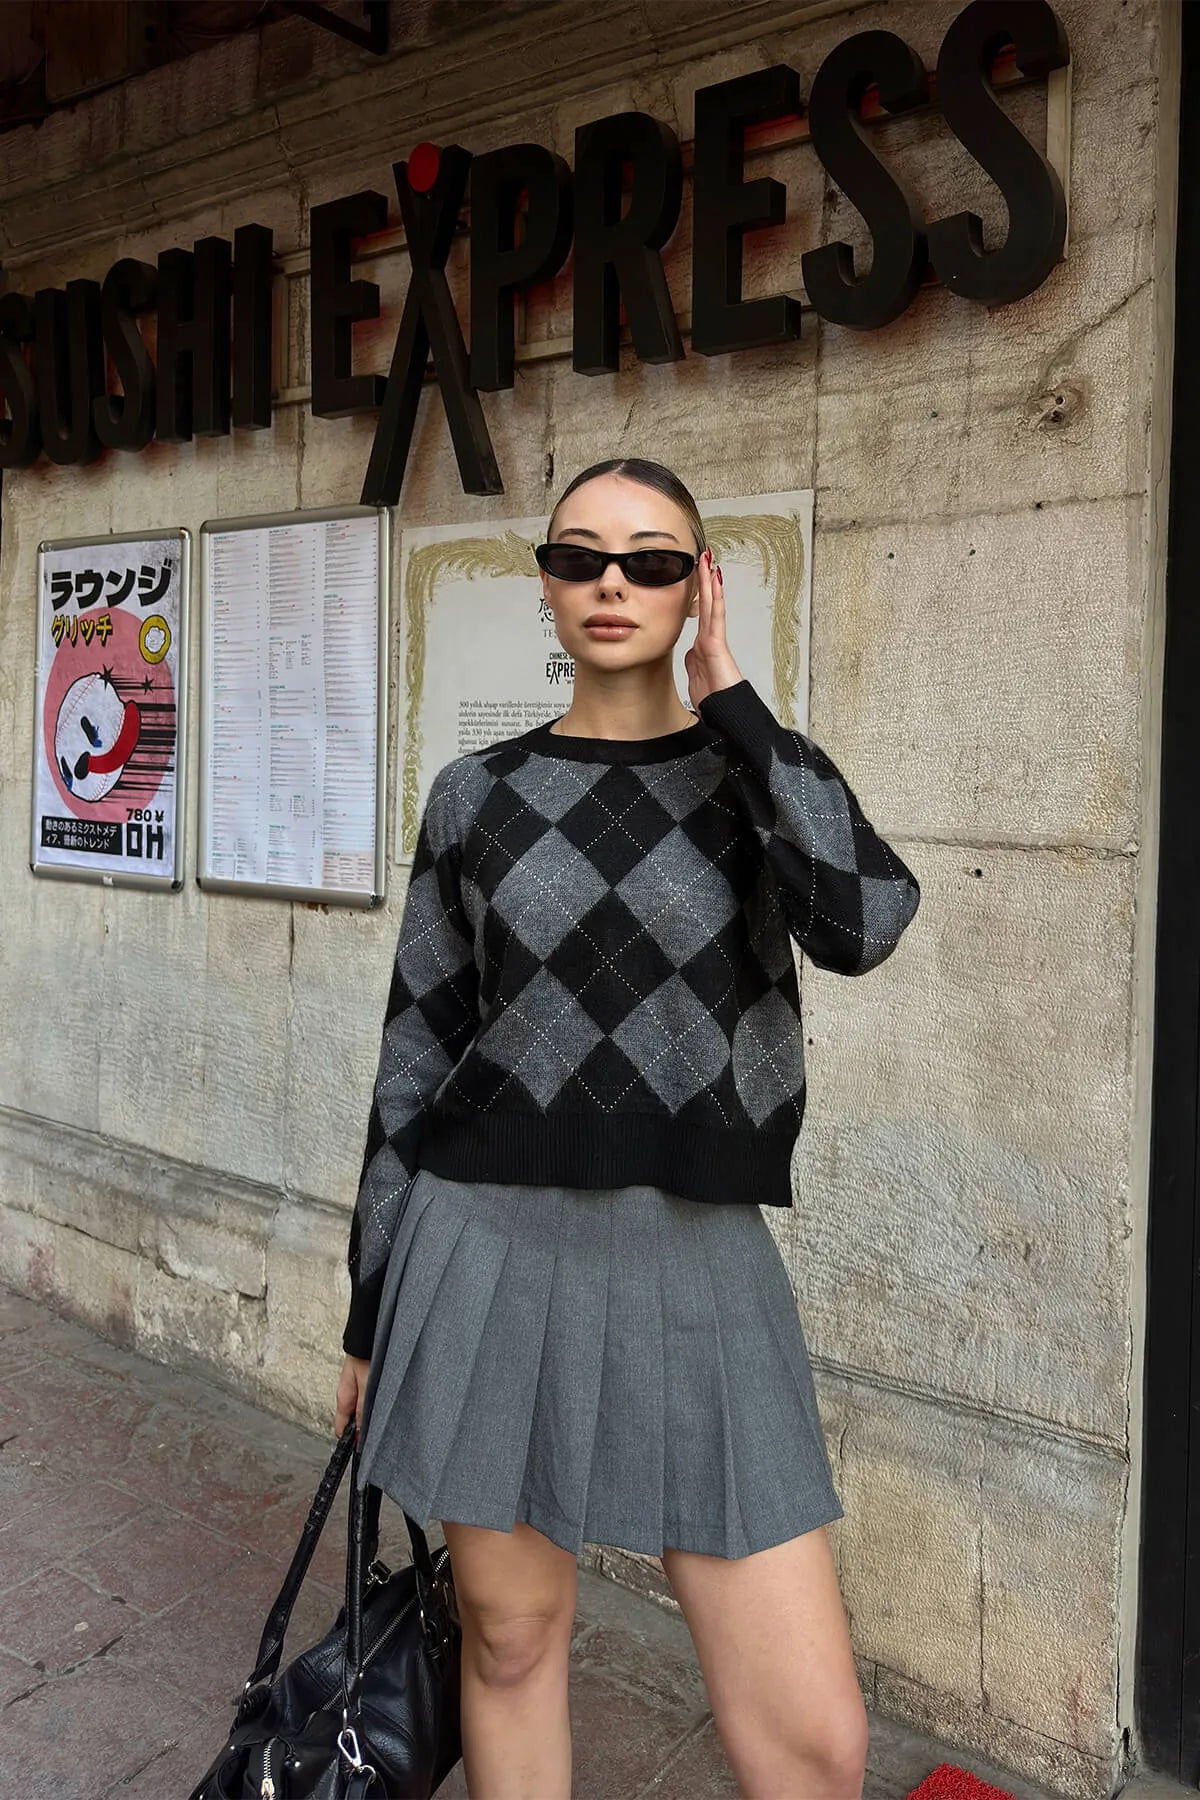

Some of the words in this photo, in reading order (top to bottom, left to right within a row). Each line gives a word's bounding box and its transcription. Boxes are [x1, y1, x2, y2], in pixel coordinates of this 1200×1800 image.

[0, 223, 274, 468] SUSHI
[310, 0, 1070, 506] EXPRESS
[51, 558, 172, 611] ラウンジ
[546, 661, 575, 684] EXPRE
[126, 808, 152, 822] 780
